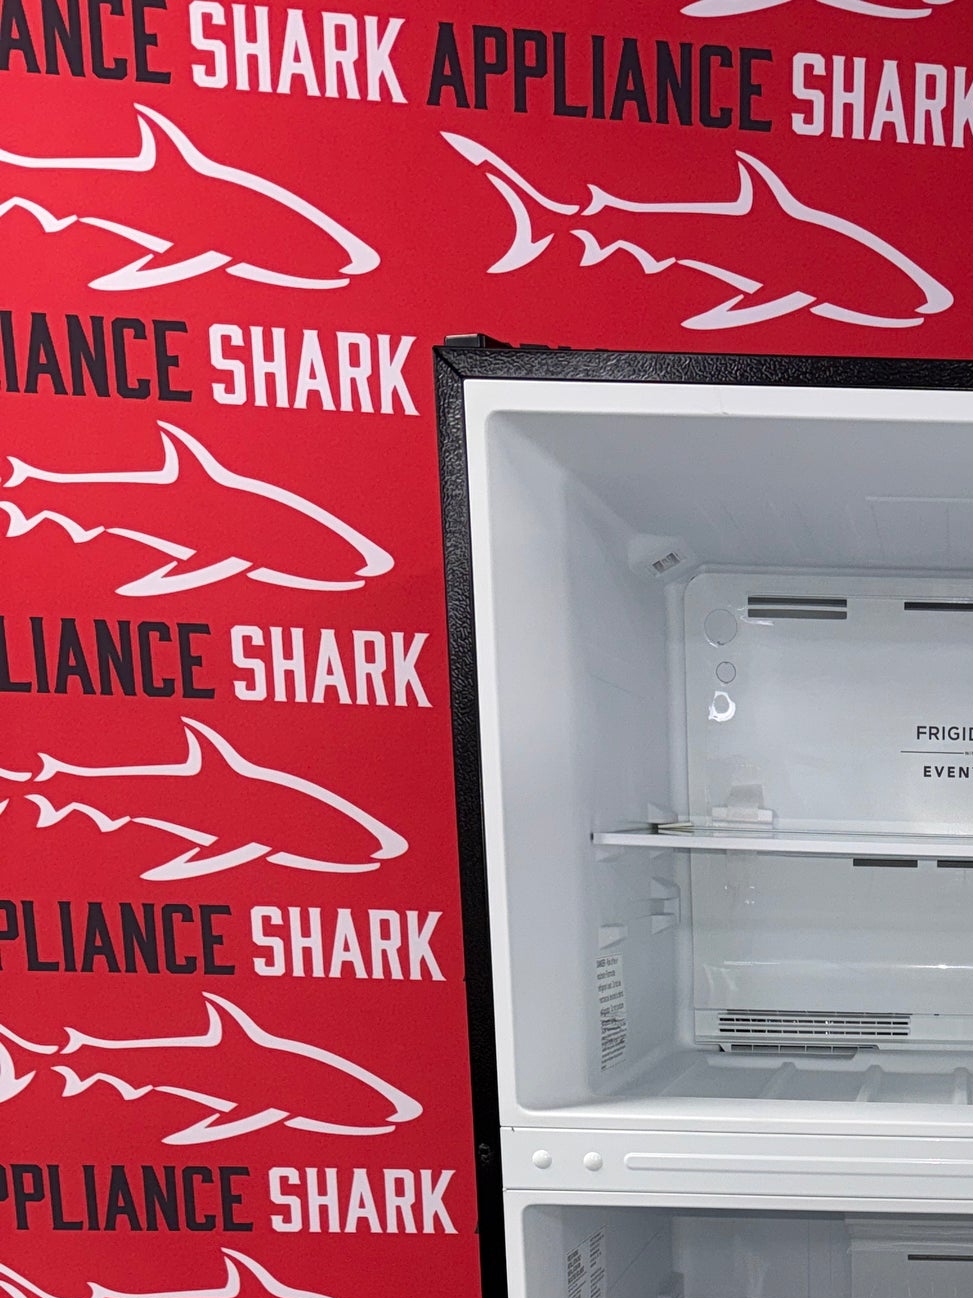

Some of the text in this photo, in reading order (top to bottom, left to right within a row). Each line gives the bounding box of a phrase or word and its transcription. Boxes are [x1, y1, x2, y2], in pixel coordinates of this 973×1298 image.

[0, 0, 171, 84] ANCE
[188, 0, 408, 104] SHARK
[427, 22, 772, 132] APPLIANCE
[0, 310, 420, 416] IANCE SHARK
[0, 615, 433, 708] LIANCE SHARK
[250, 905, 446, 981] SHARK
[0, 1164, 458, 1234] PLIANCE SHARK
